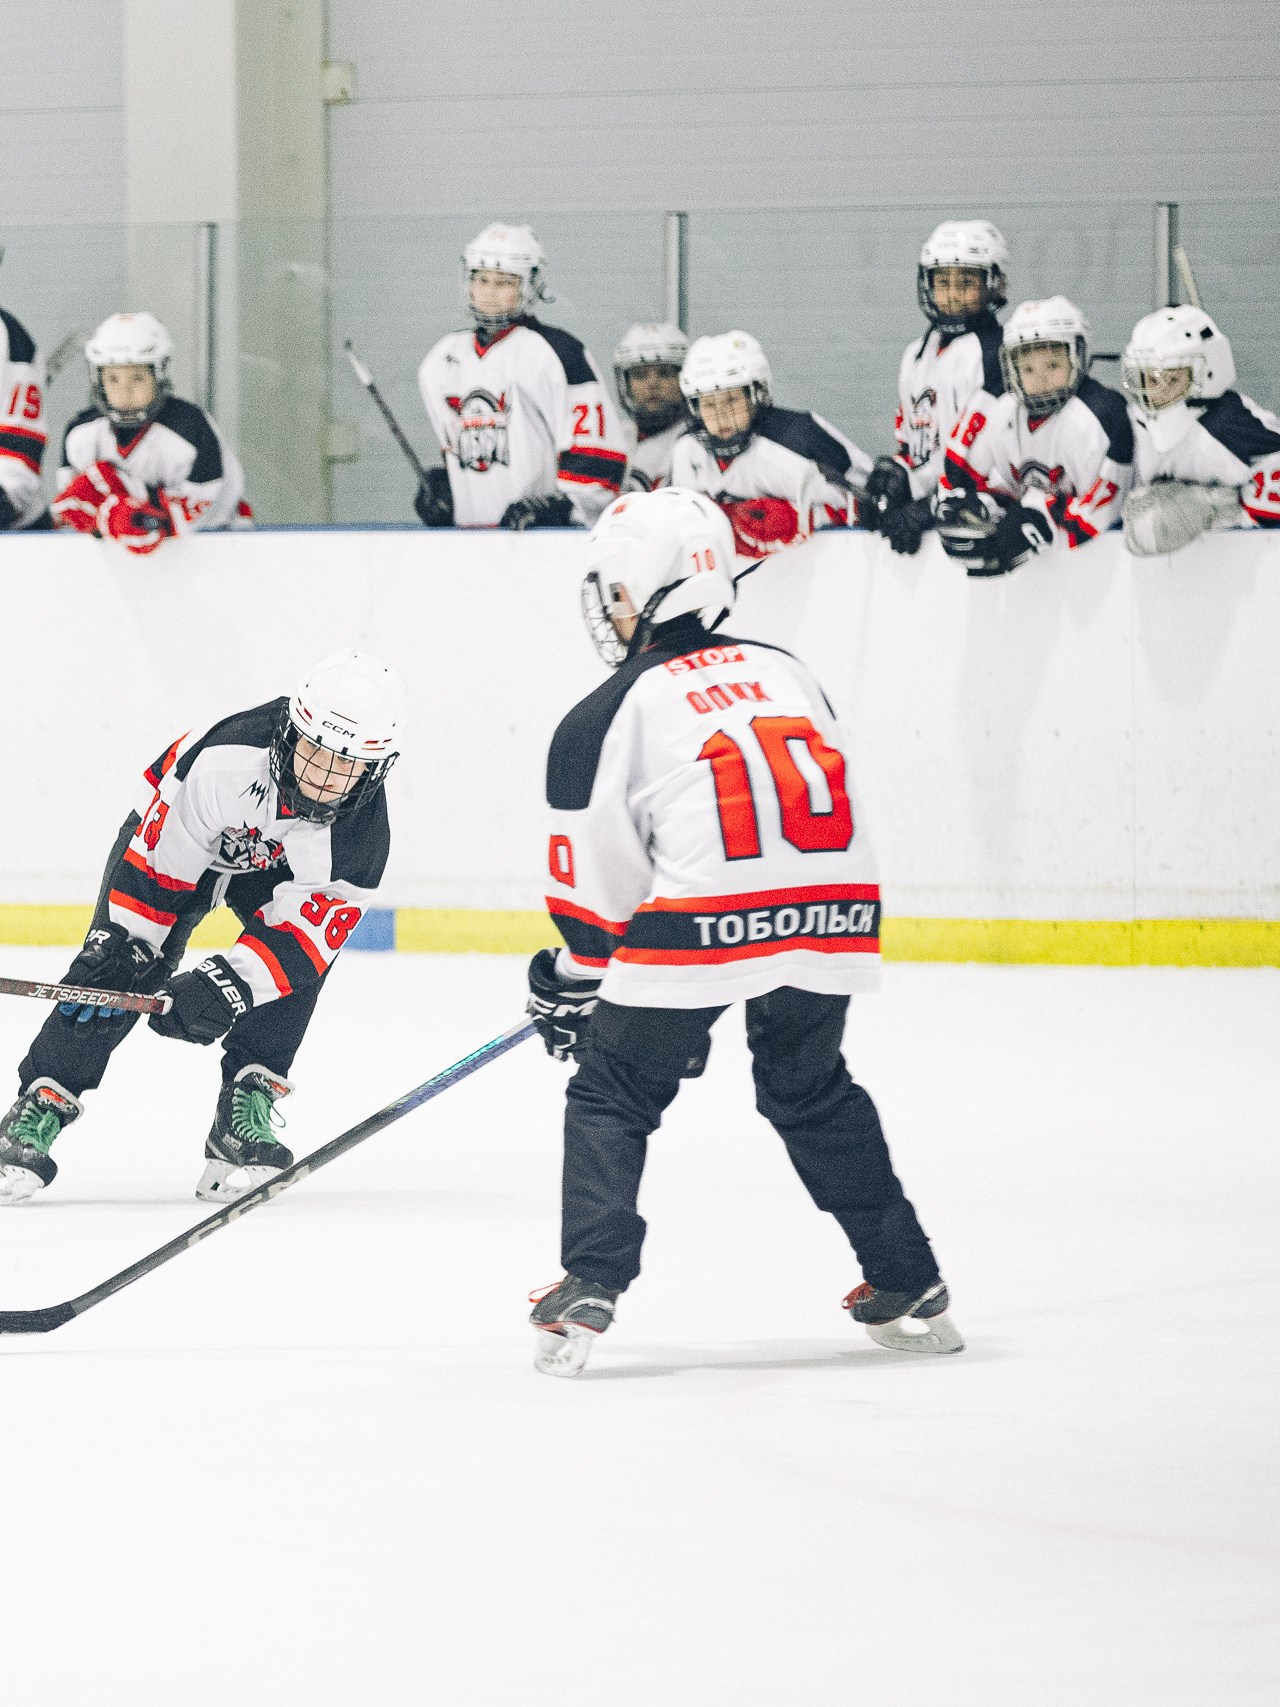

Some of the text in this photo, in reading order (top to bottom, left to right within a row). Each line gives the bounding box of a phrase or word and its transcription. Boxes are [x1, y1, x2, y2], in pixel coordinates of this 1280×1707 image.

[573, 403, 606, 437] 21
[692, 548, 715, 574] 10
[665, 645, 745, 676] STOP
[321, 720, 357, 739] CCM
[696, 715, 855, 863] 10
[300, 892, 362, 950] 98
[693, 903, 876, 947] ТОБОЛЬСК
[27, 984, 111, 1007] JETSPEED
